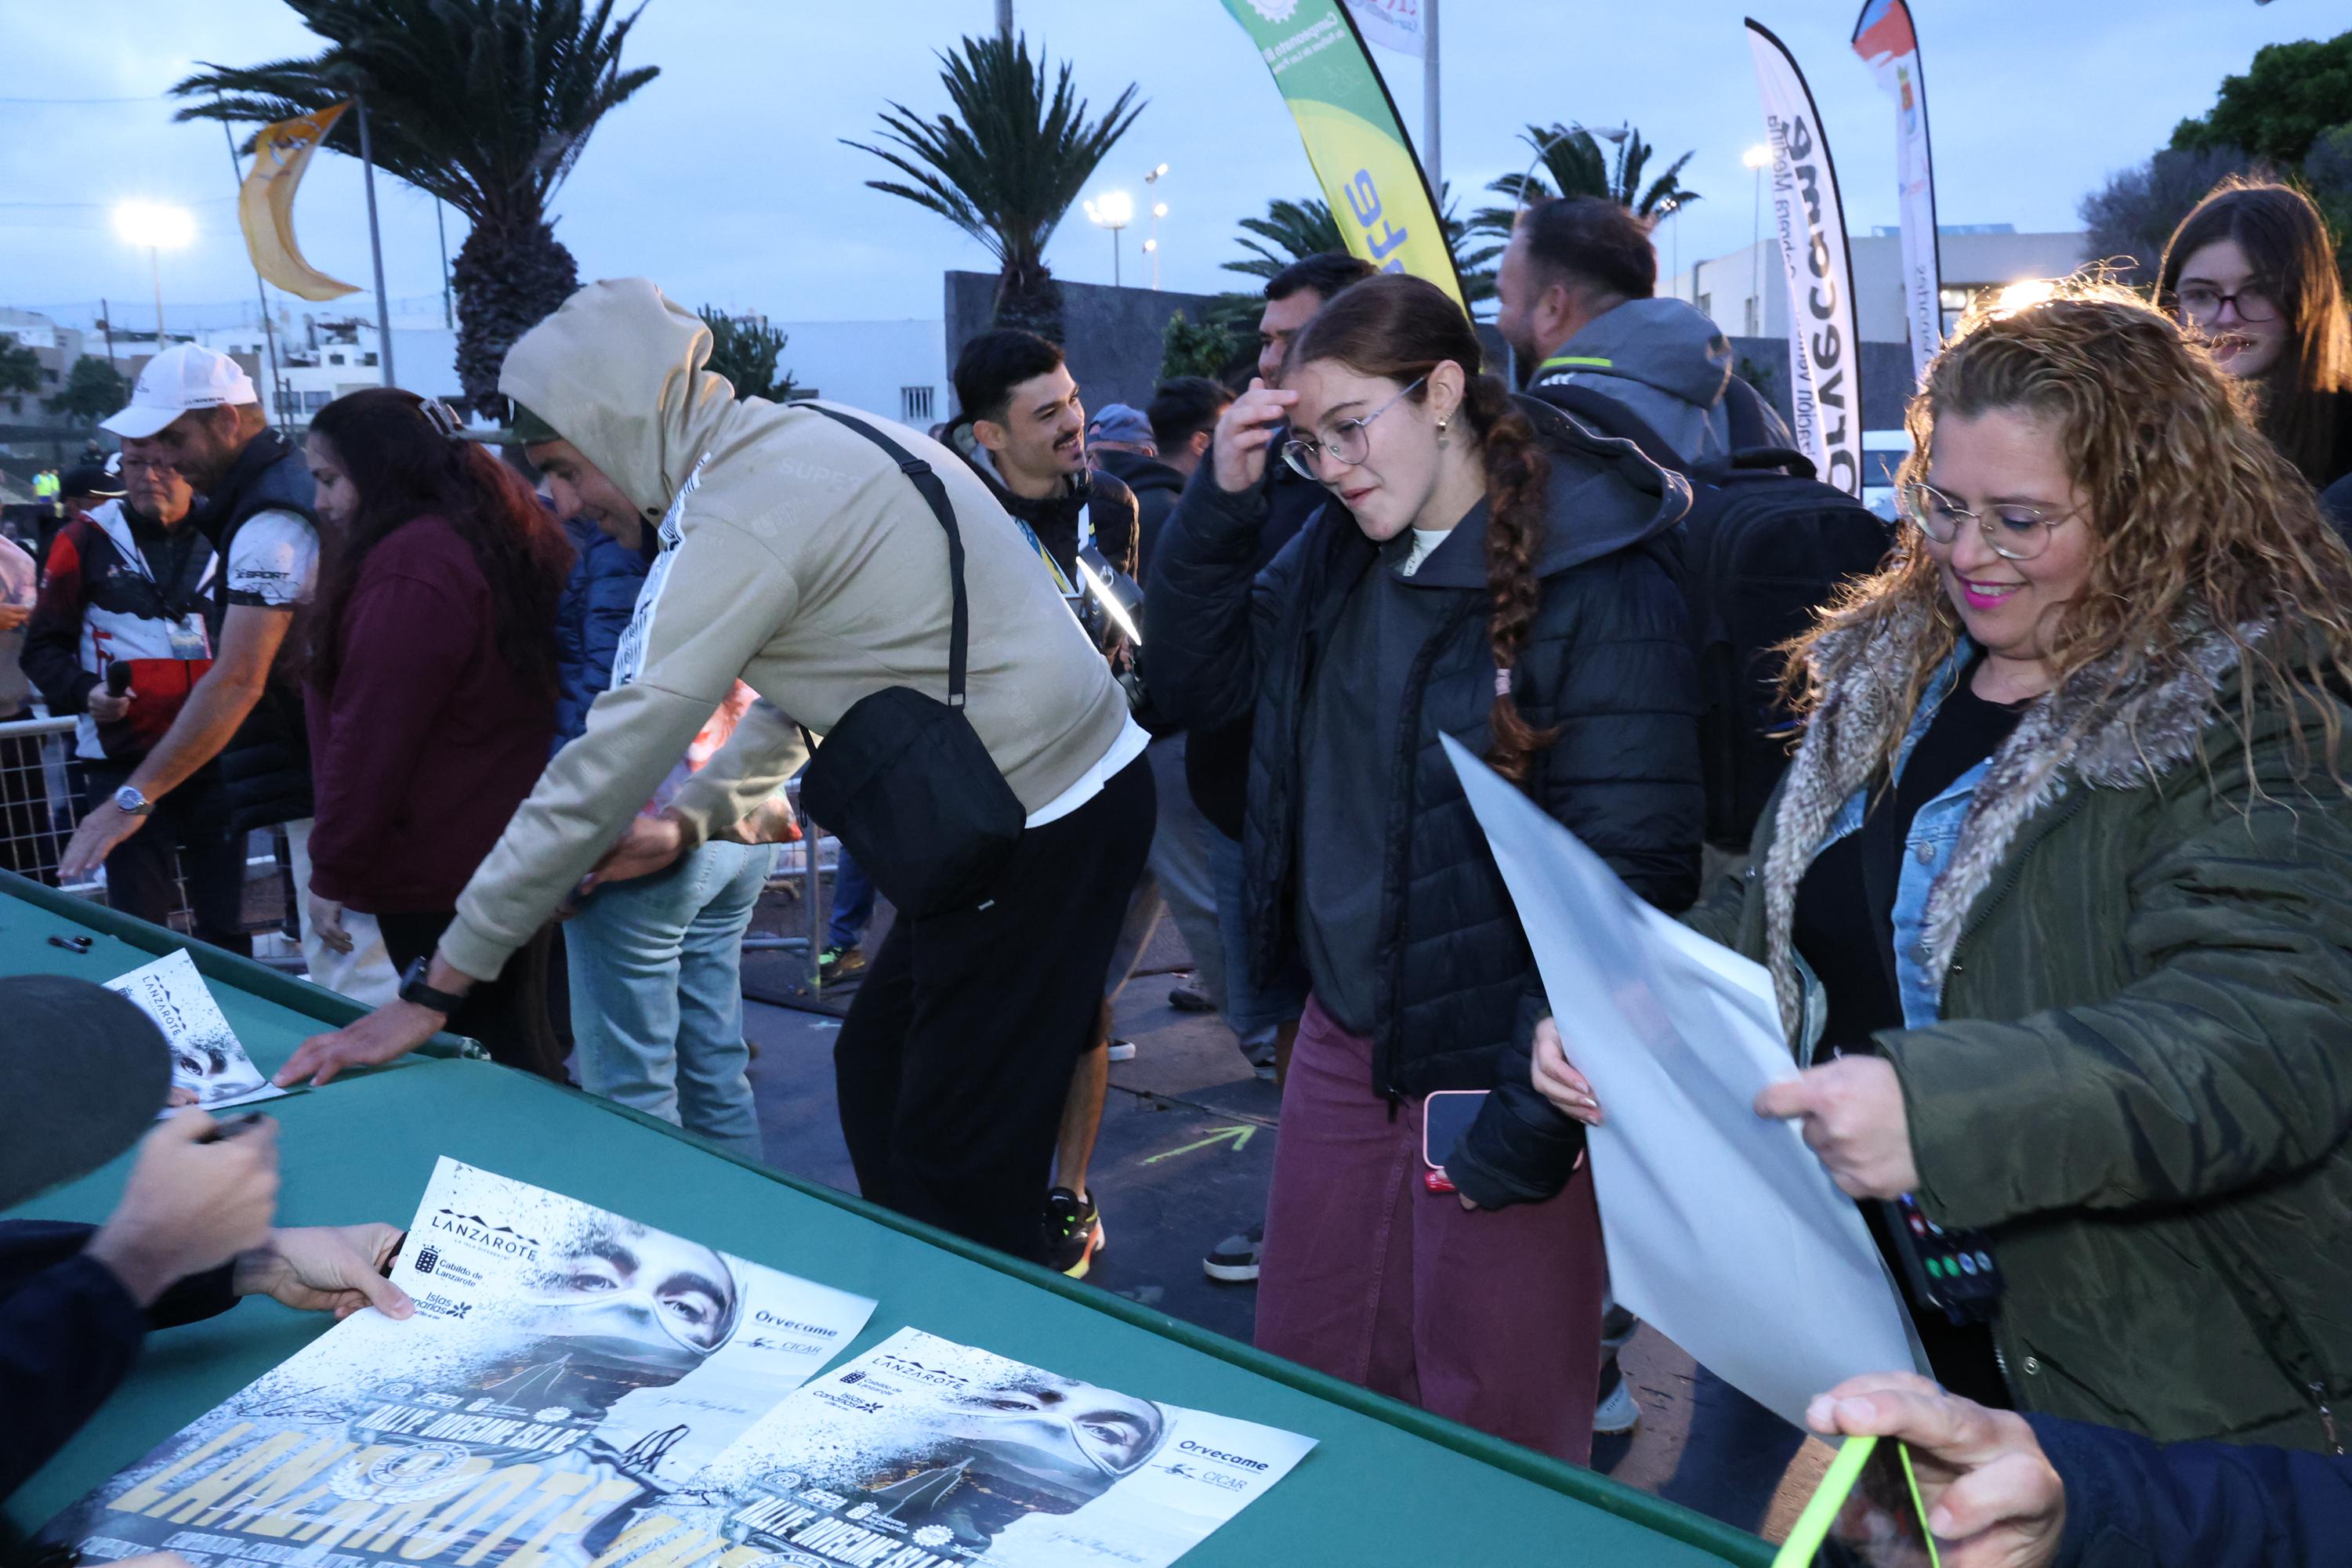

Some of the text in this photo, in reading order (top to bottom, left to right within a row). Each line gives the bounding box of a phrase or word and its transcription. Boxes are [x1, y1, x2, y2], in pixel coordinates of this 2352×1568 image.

[142, 976, 182, 1037] LANZAROTE
[432, 1216, 538, 1262] LANZAROTE
[435, 1268, 477, 1287] Lanzarote
[439, 1259, 484, 1281] Cabildo de
[409, 1297, 448, 1316] anarias
[426, 1292, 452, 1307] Islas
[756, 1310, 839, 1337] Orvecame
[783, 1341, 823, 1354] CICAR
[872, 1357, 965, 1390] LANZAROTE
[857, 1382, 894, 1396] Lanzarote
[864, 1378, 893, 1390] Cabildo
[813, 1390, 858, 1408] Canarias
[840, 1392, 866, 1404] Islas
[1179, 1440, 1270, 1472] Orvecame
[1202, 1472, 1248, 1490] CICAR
[731, 1495, 818, 1537] RALLYE
